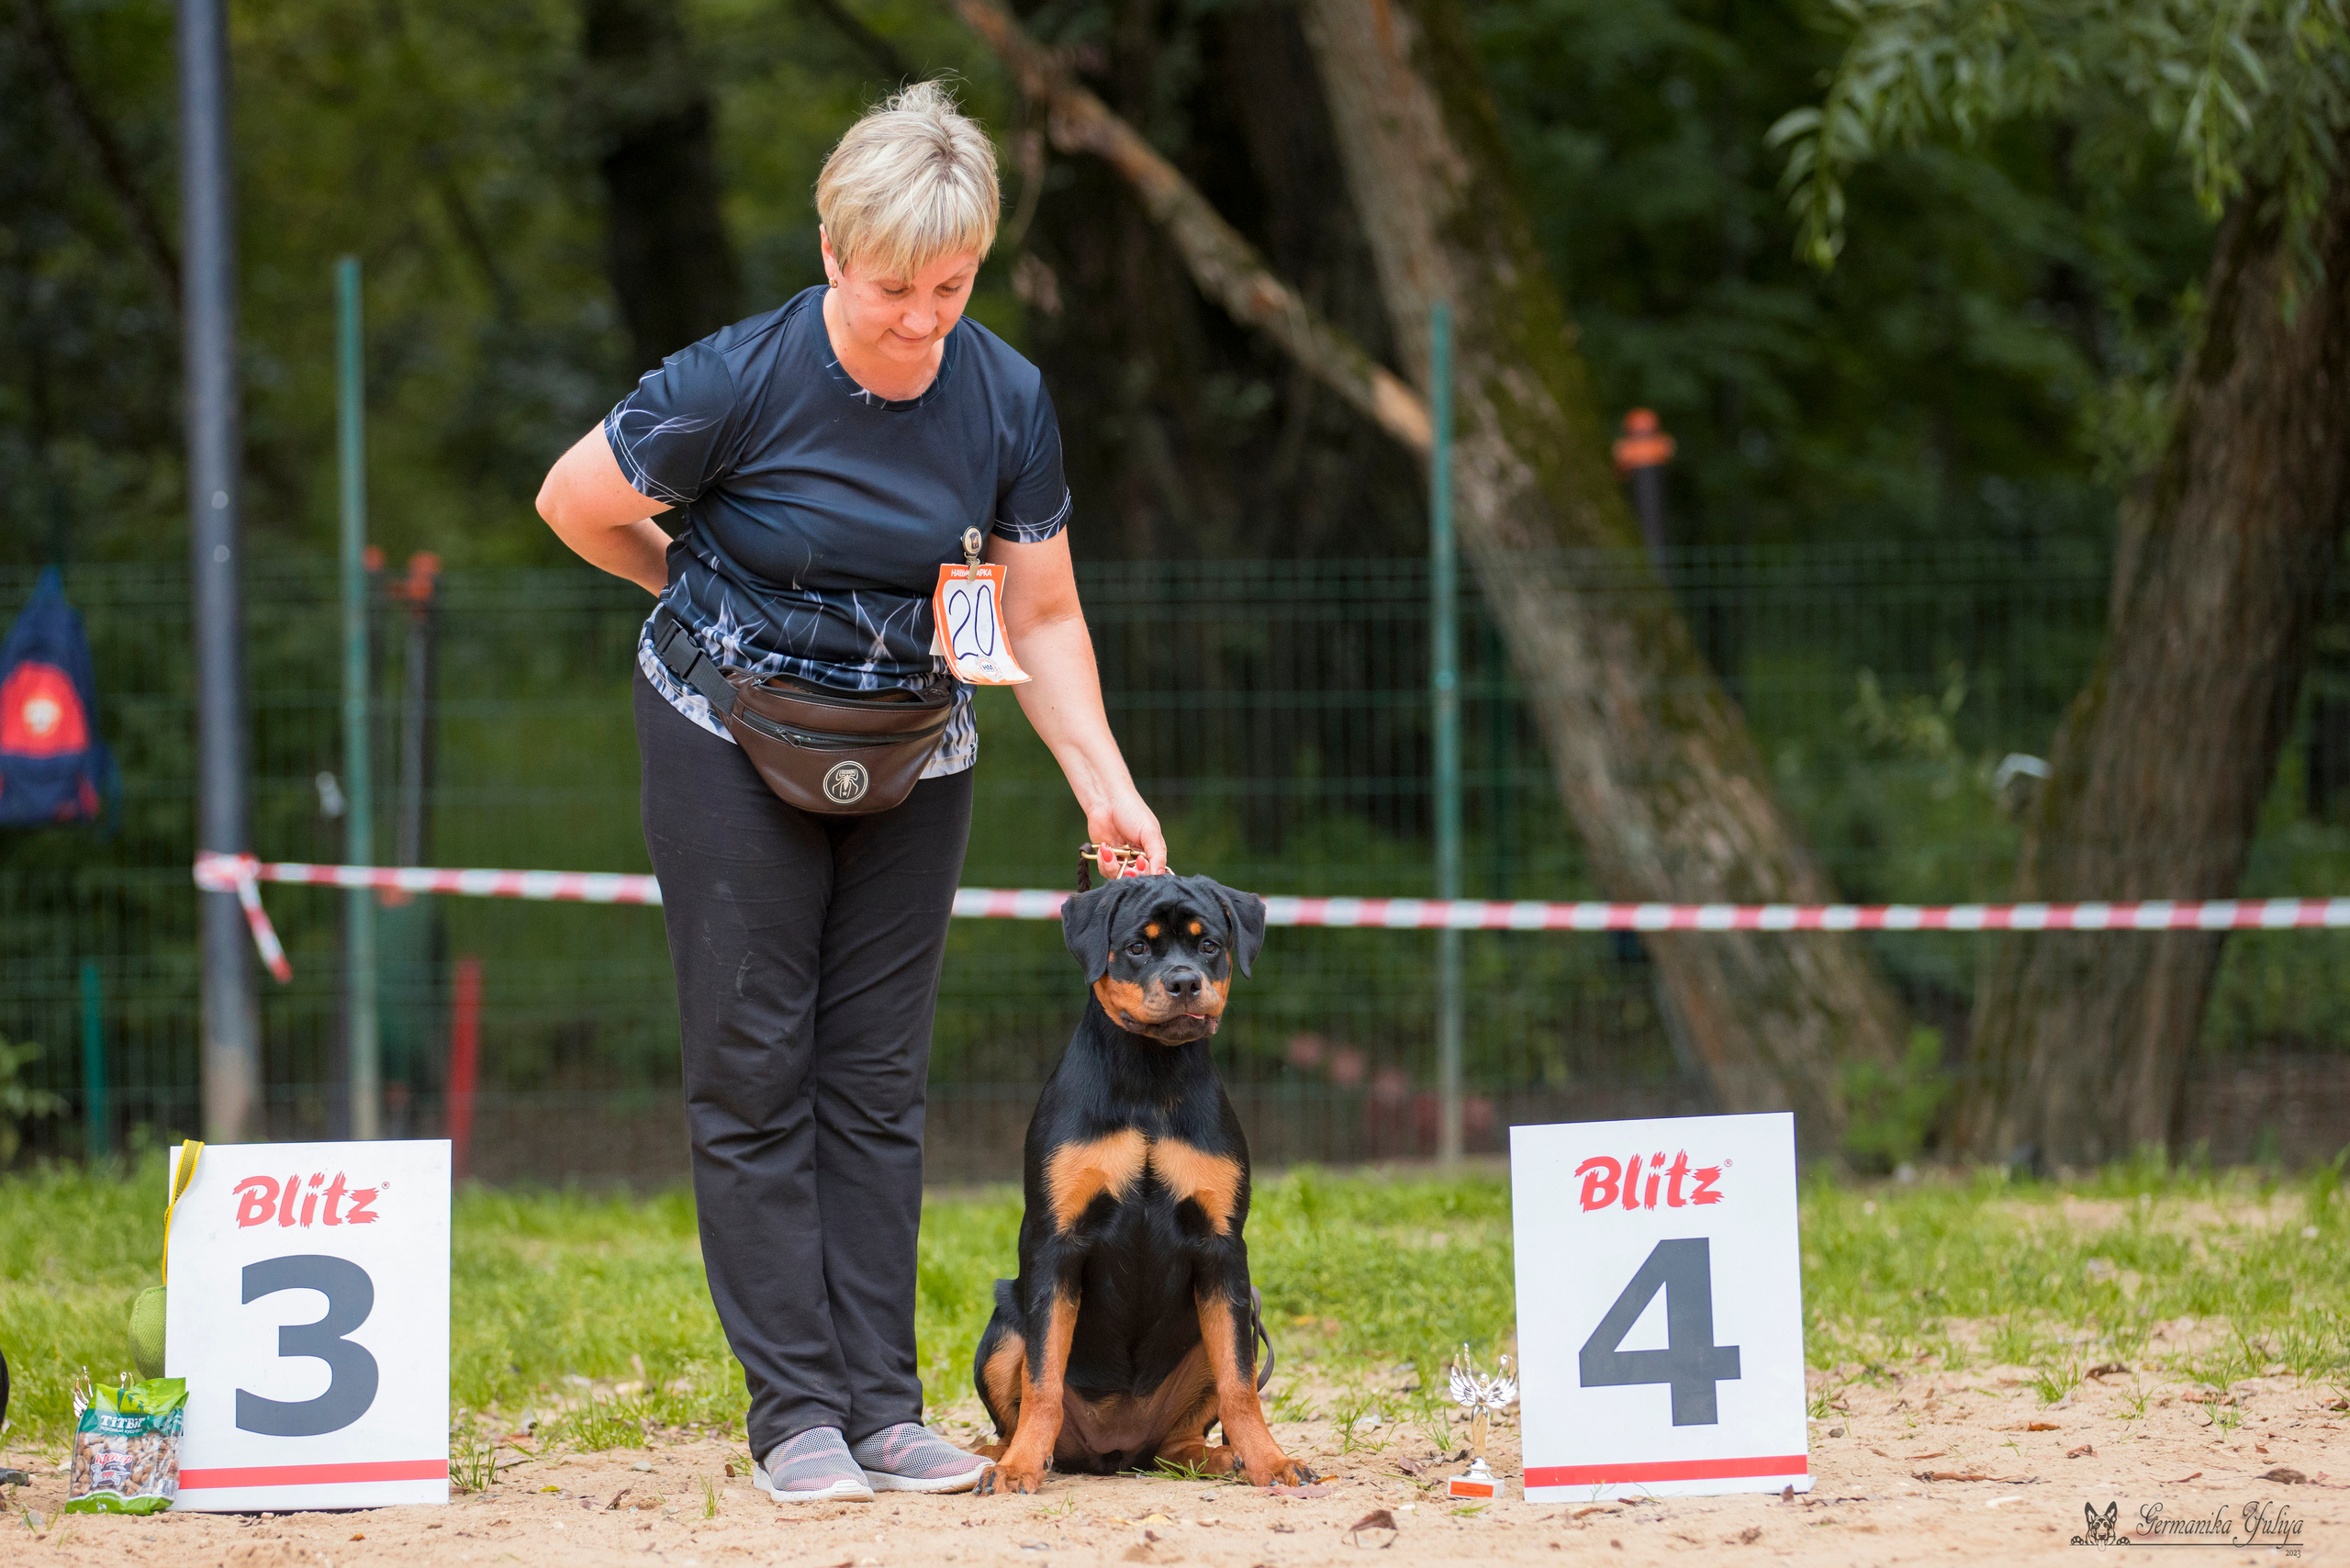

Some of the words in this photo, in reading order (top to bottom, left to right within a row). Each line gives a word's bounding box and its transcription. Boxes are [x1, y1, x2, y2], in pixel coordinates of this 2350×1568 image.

[975, 568, 992, 577] АРКА
[948, 584, 995, 660] 20
[232, 1170, 380, 1229] Blitz
[1574, 1148, 1725, 1214] Blitz
[235, 1254, 379, 1437] 3
[1579, 1238, 1741, 1426] 4
